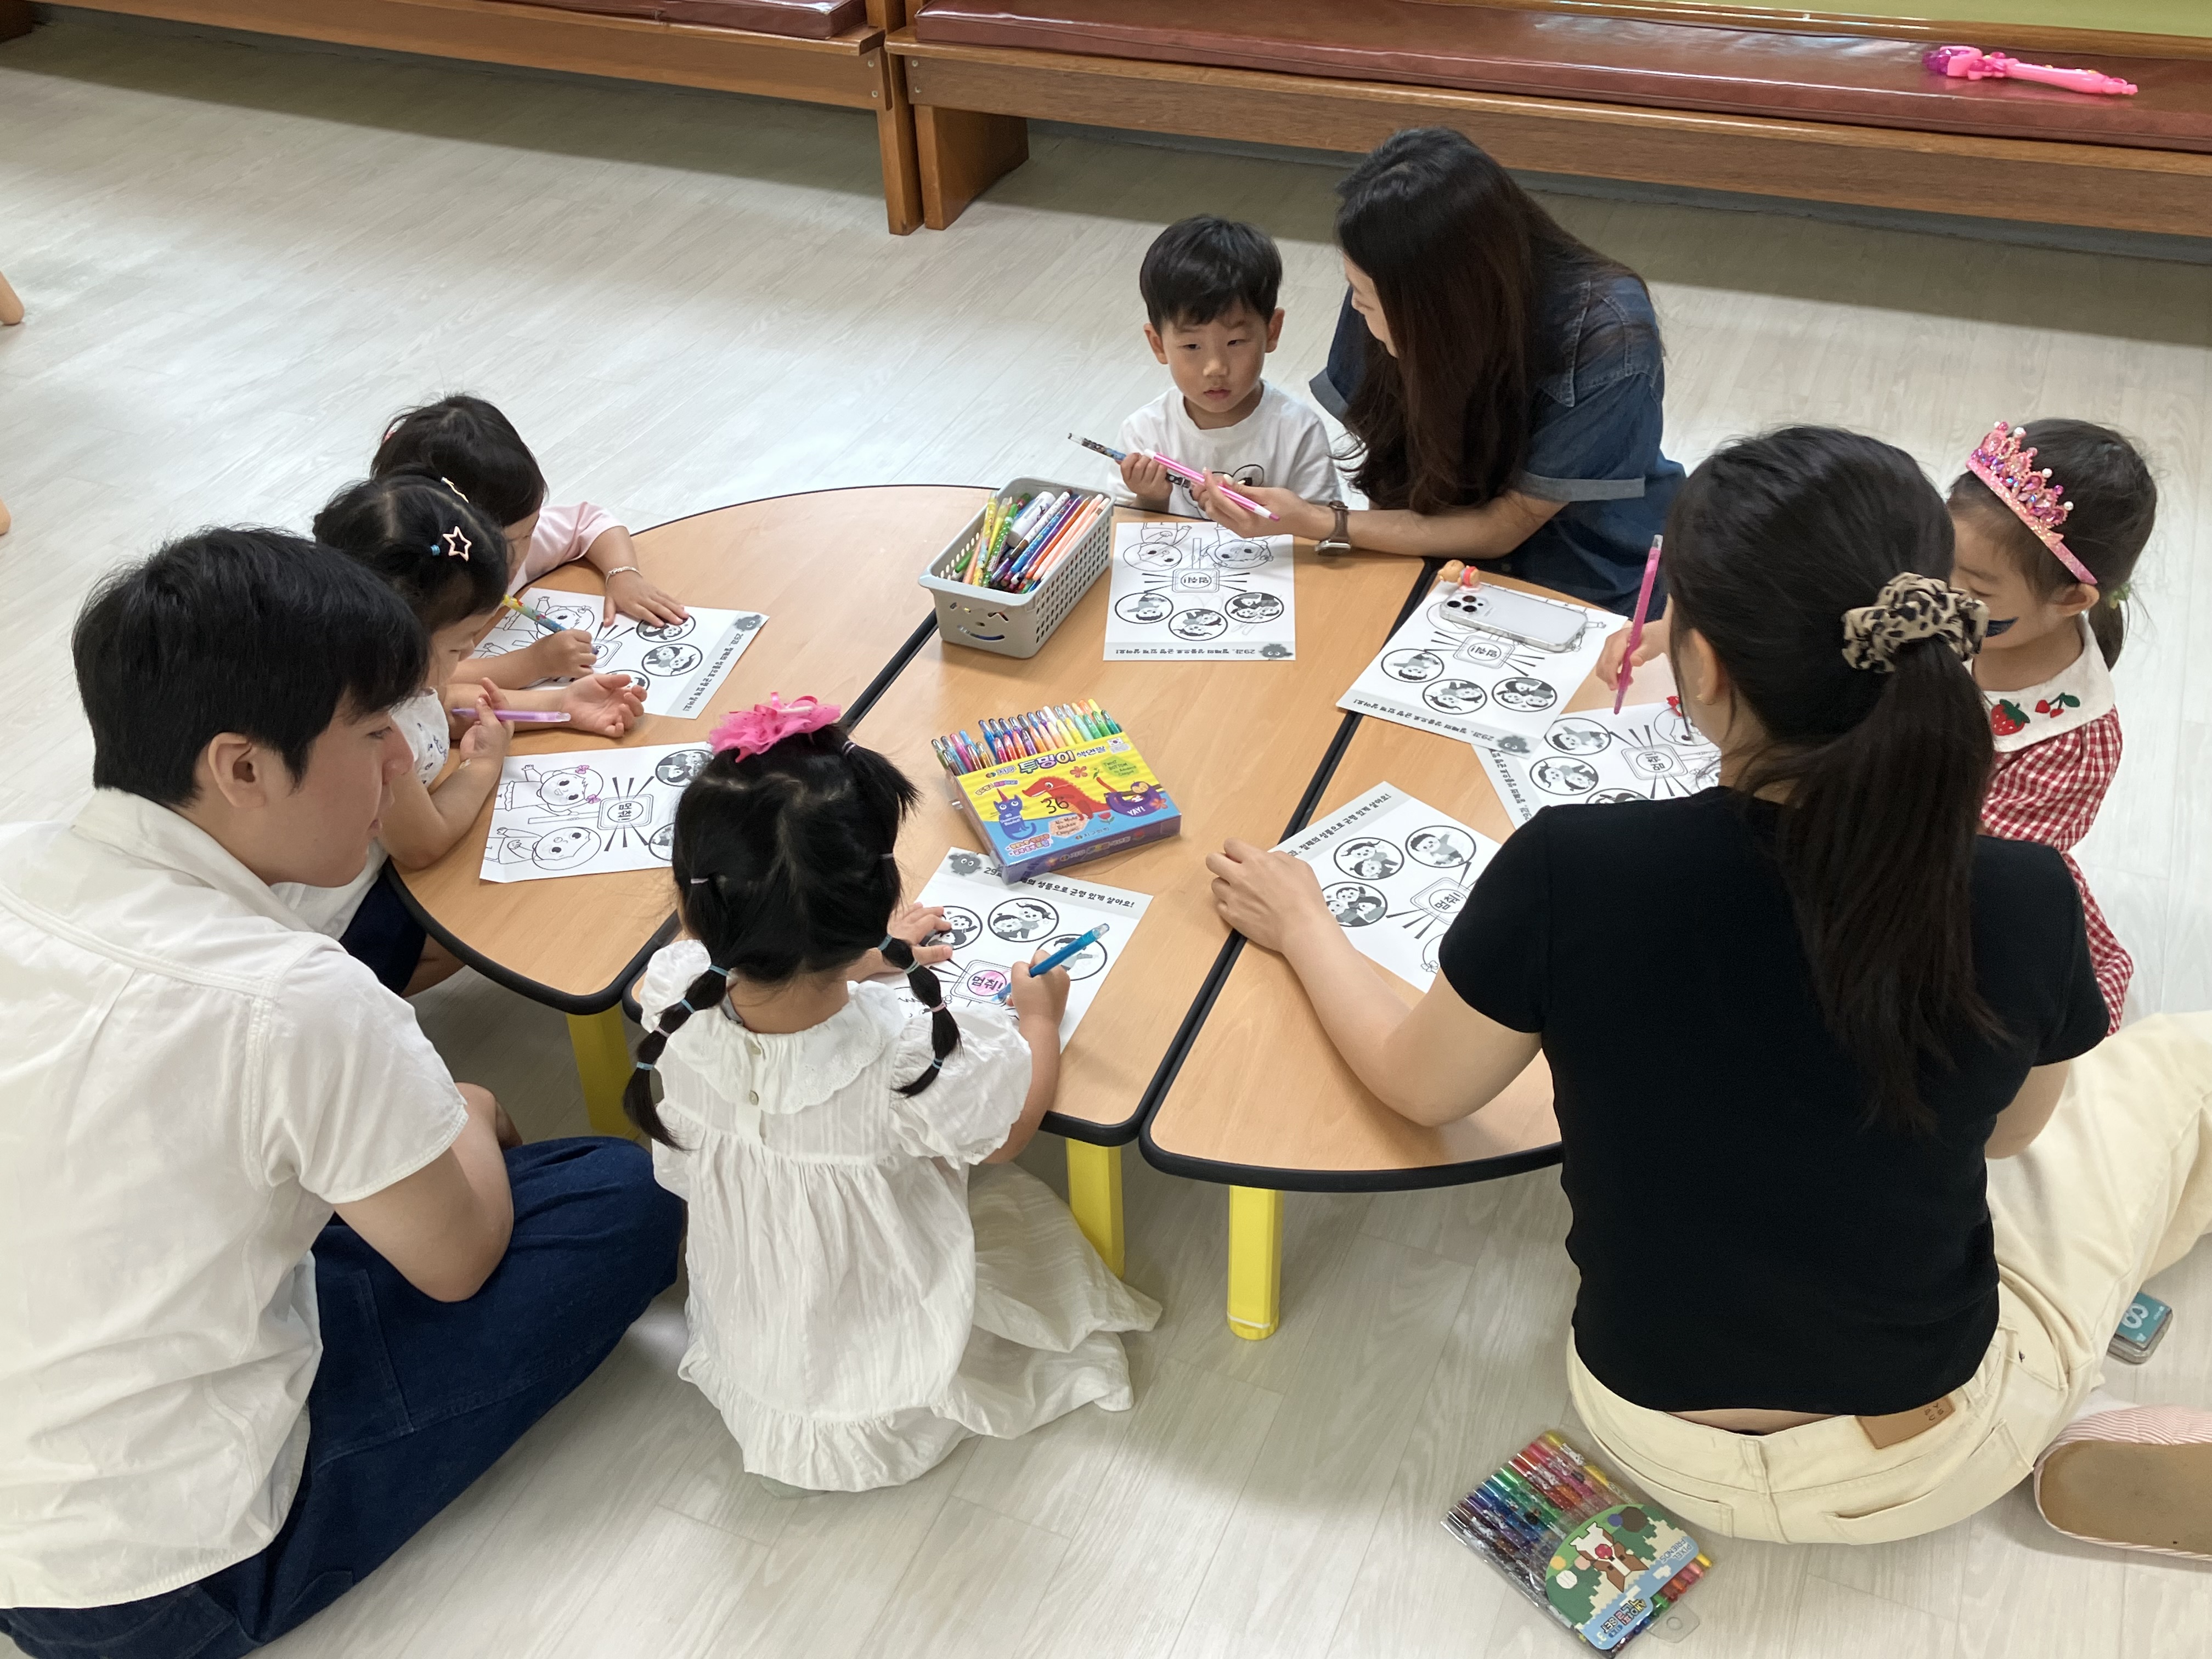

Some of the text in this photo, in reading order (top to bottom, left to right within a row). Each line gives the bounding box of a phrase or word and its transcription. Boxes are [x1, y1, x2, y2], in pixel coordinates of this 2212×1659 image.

[1018, 749, 1076, 774] 투명이
[618, 803, 632, 821] 멈춰!
[1041, 797, 1069, 814] 36
[1127, 806, 1146, 816] YAY!
[1037, 881, 1069, 893] 성품으로
[1069, 888, 1087, 898] 균형
[1087, 892, 1105, 901] 있게
[1107, 896, 1135, 908] 살아요!
[1434, 892, 1464, 910] 멈춰!
[972, 975, 1003, 991] 멈춰!
[1659, 1538, 1686, 1563] FRIENDS
[1673, 1542, 1692, 1560] PIXEL
[1601, 1617, 1618, 1634] SET
